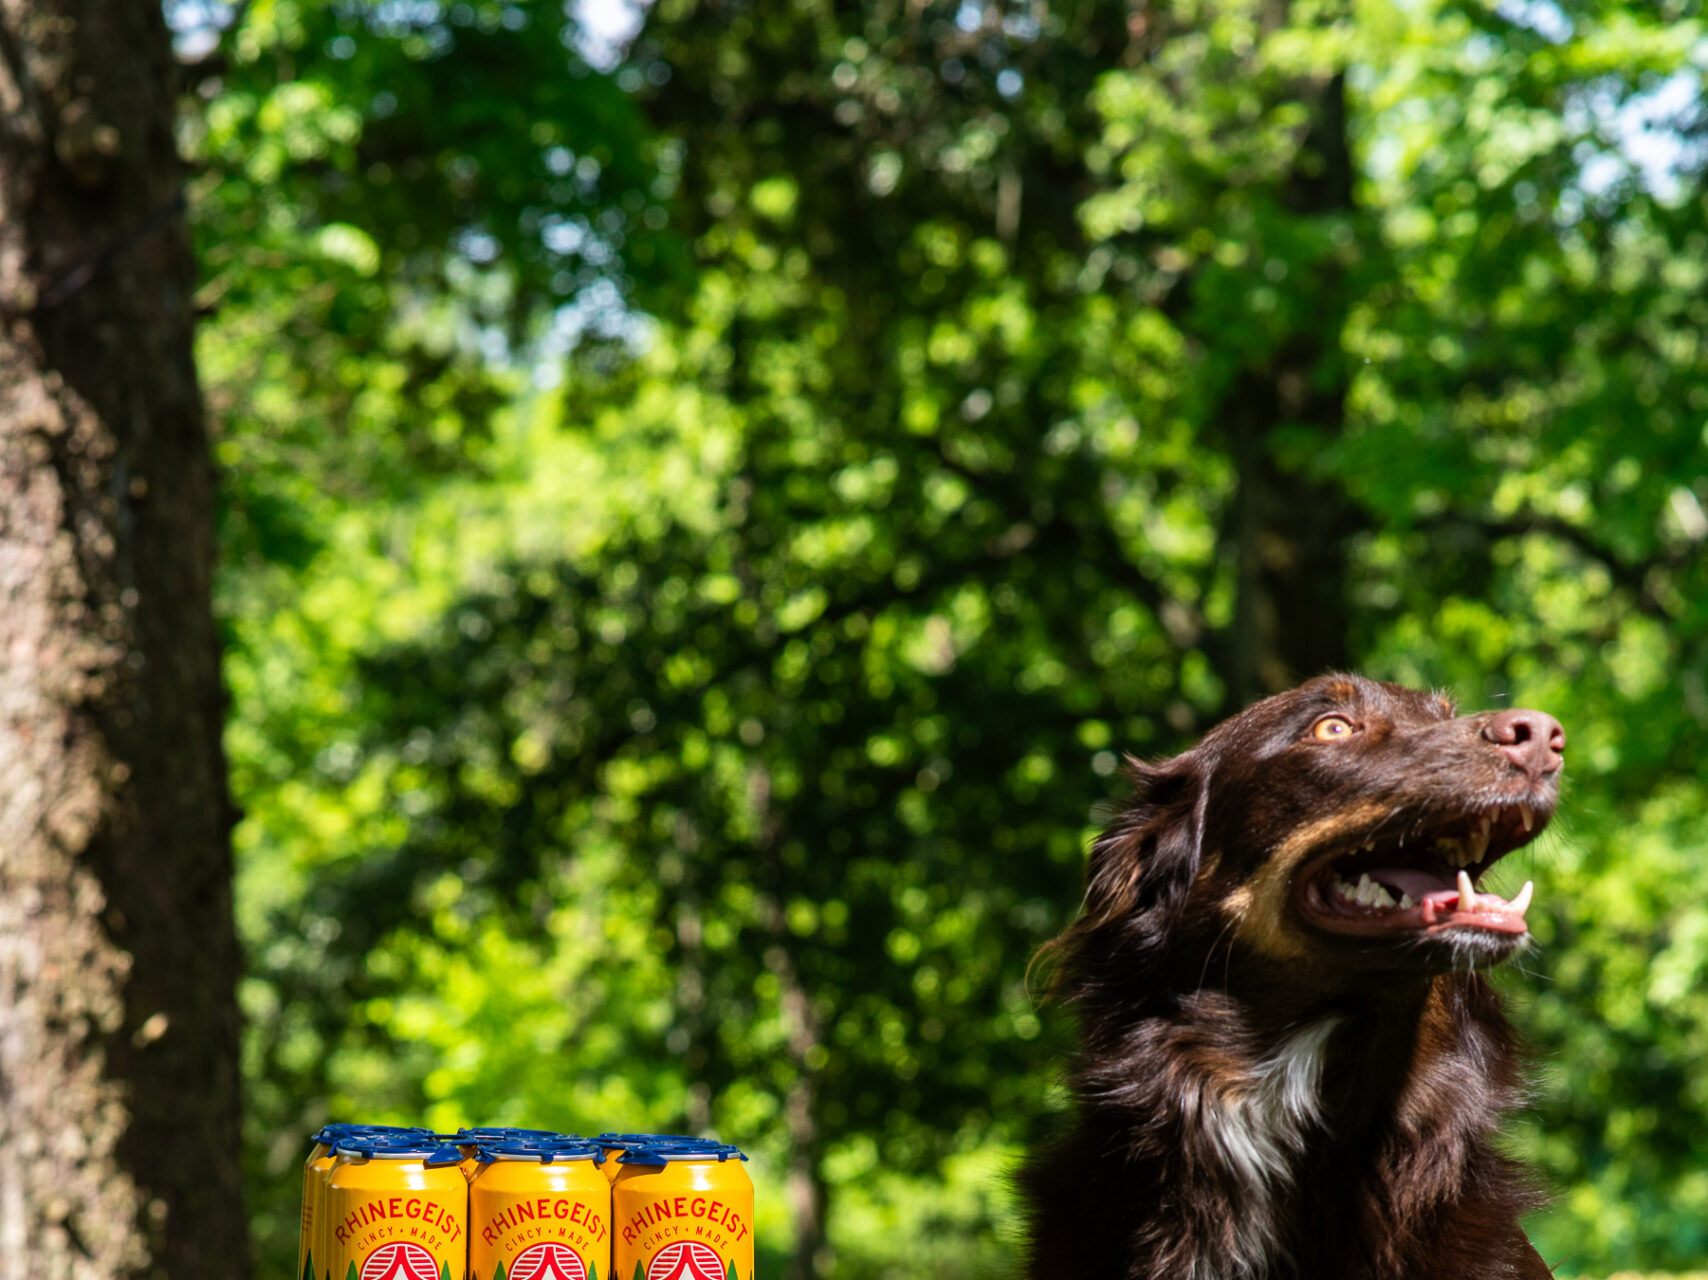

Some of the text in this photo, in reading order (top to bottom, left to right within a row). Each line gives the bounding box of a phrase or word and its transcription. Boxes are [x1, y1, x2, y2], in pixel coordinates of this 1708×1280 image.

[334, 1197, 462, 1246] RHINEGEIST
[357, 1226, 442, 1252] CINCY MADE
[481, 1198, 607, 1247] RHINEGEIST
[504, 1227, 589, 1252] CINCY MADE
[622, 1197, 748, 1246] RHINEGEIST
[643, 1225, 728, 1251] CINCY MADE
